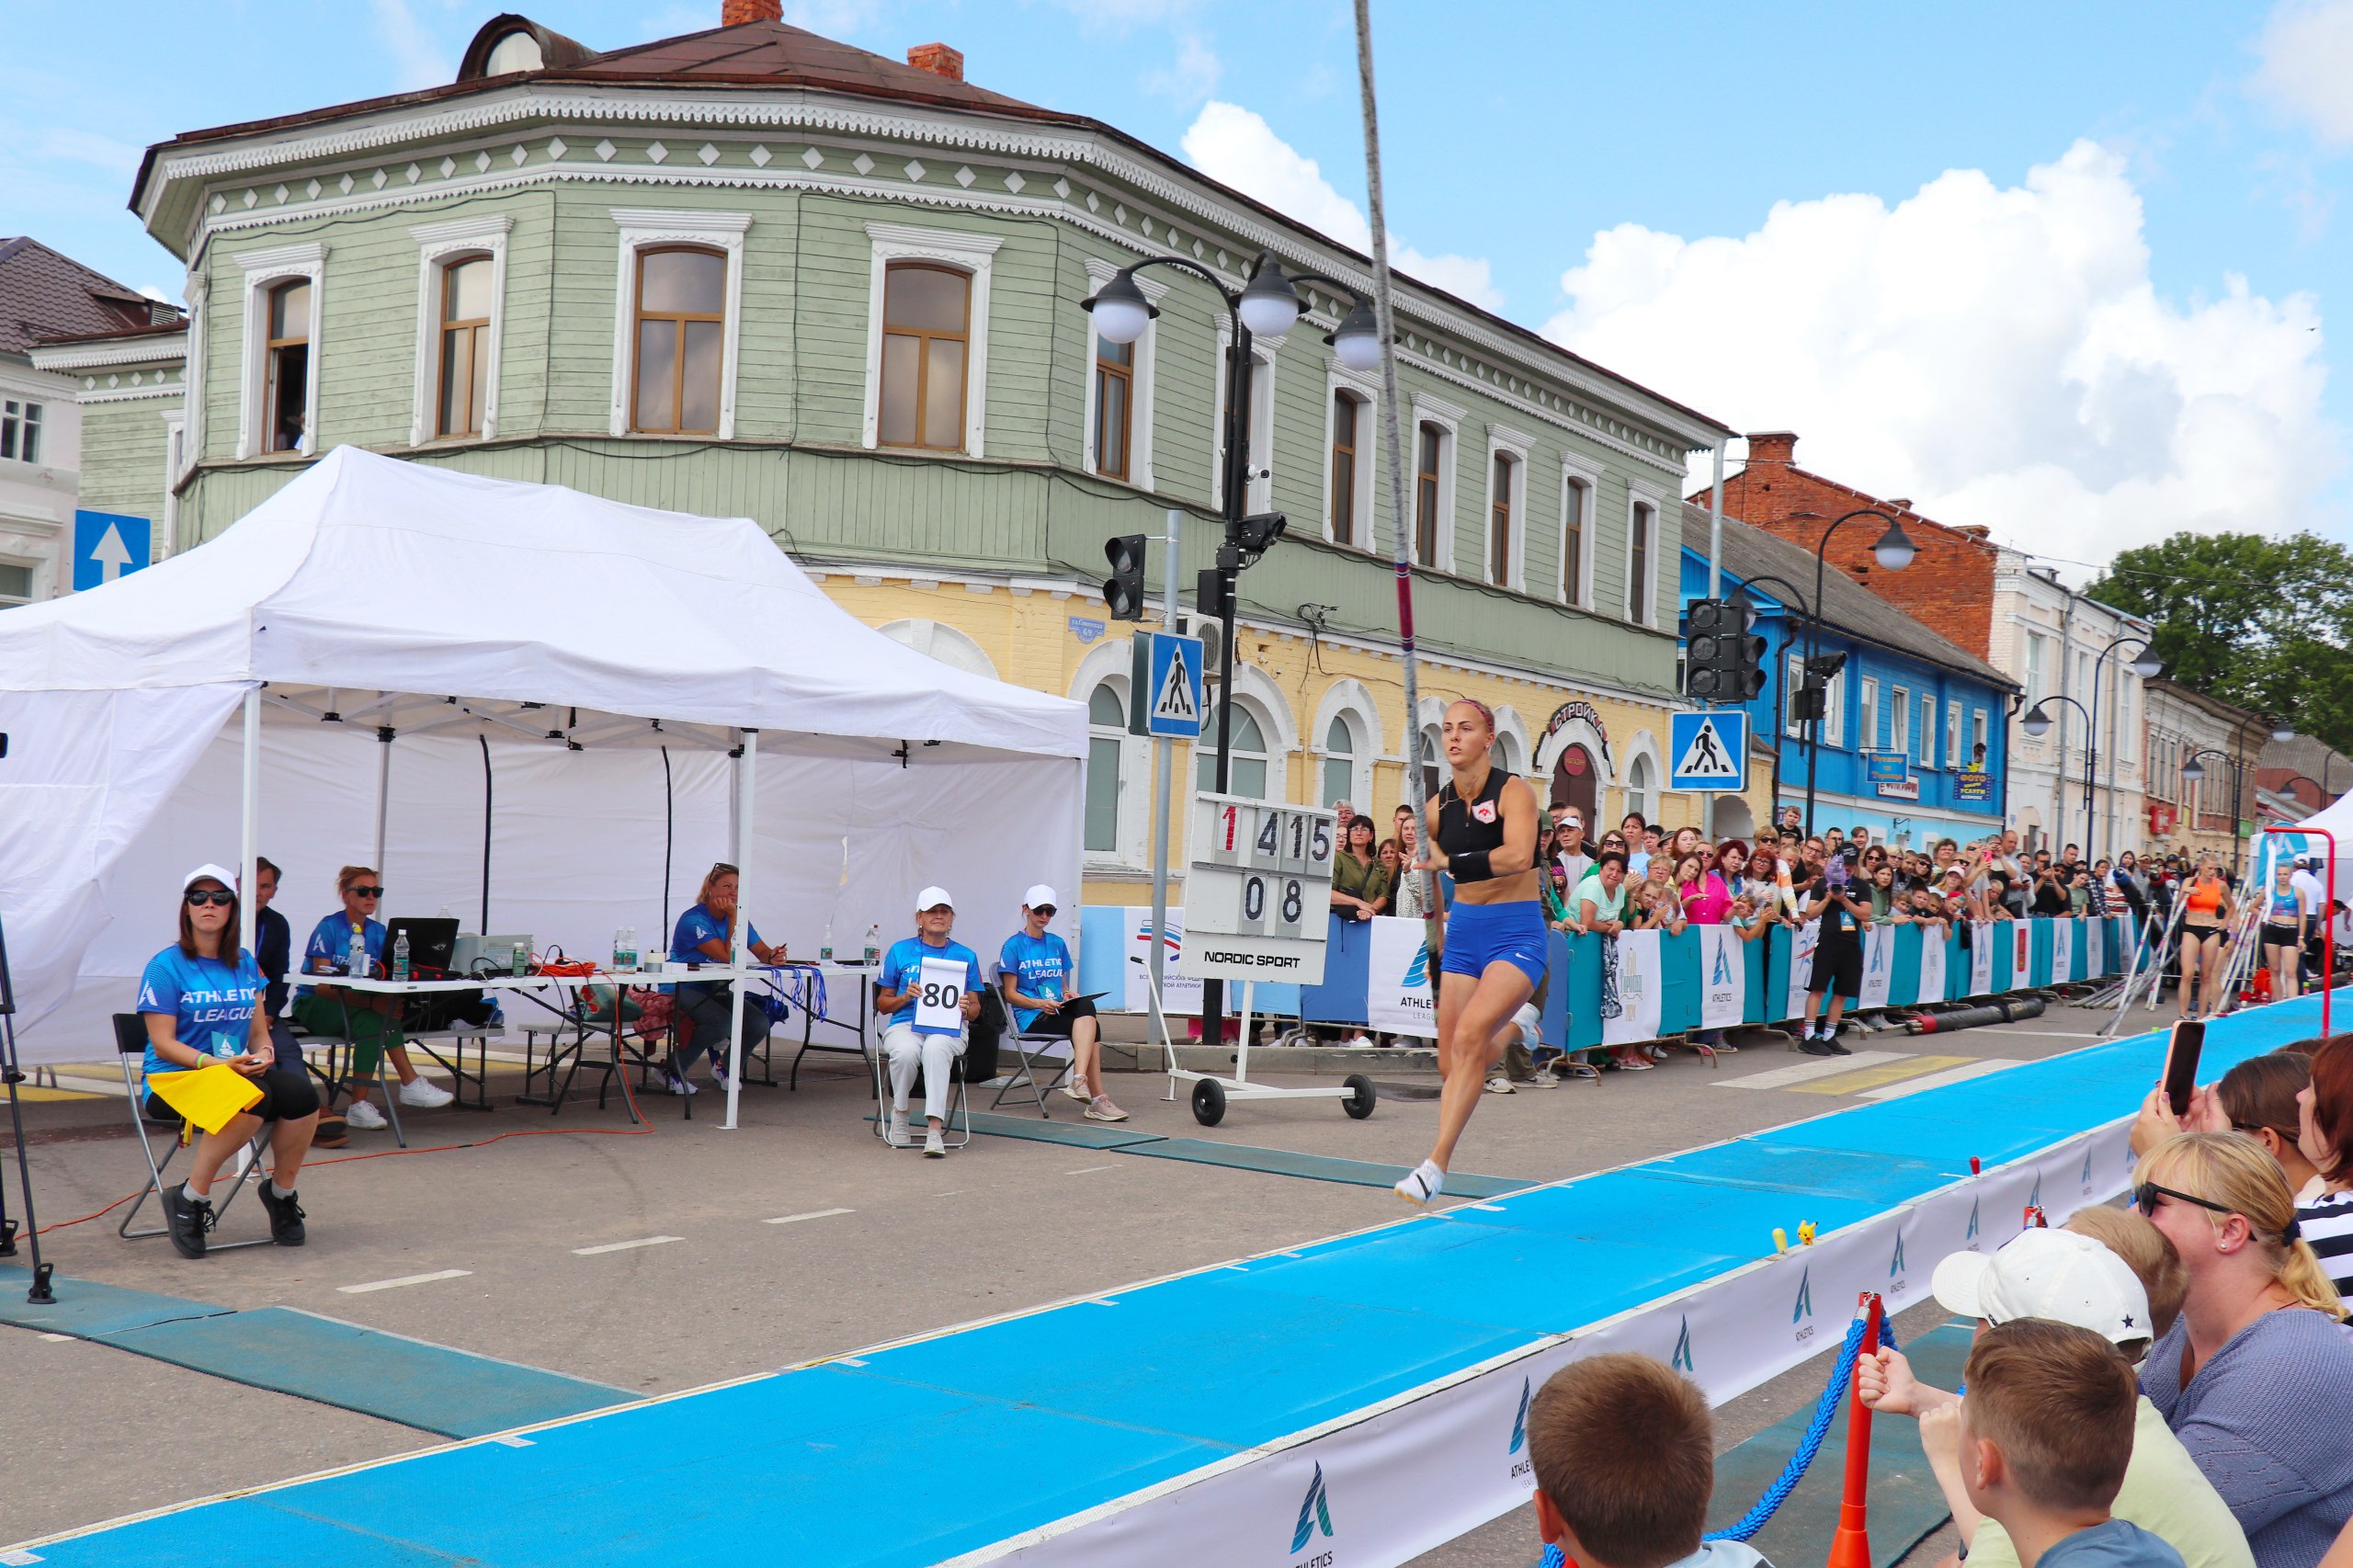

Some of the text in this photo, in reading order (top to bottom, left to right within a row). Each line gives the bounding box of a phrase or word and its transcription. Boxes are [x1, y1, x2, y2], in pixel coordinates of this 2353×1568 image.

[1554, 702, 1604, 738] СТРОЙКА
[1960, 774, 1986, 782] ФОТО
[1204, 950, 1301, 969] NORDIC SPORT
[922, 983, 959, 1009] 80
[1401, 996, 1432, 1009] ATHLE
[1712, 993, 1732, 1003] ATHLETICS
[1795, 1325, 1814, 1342] ATHLETICS
